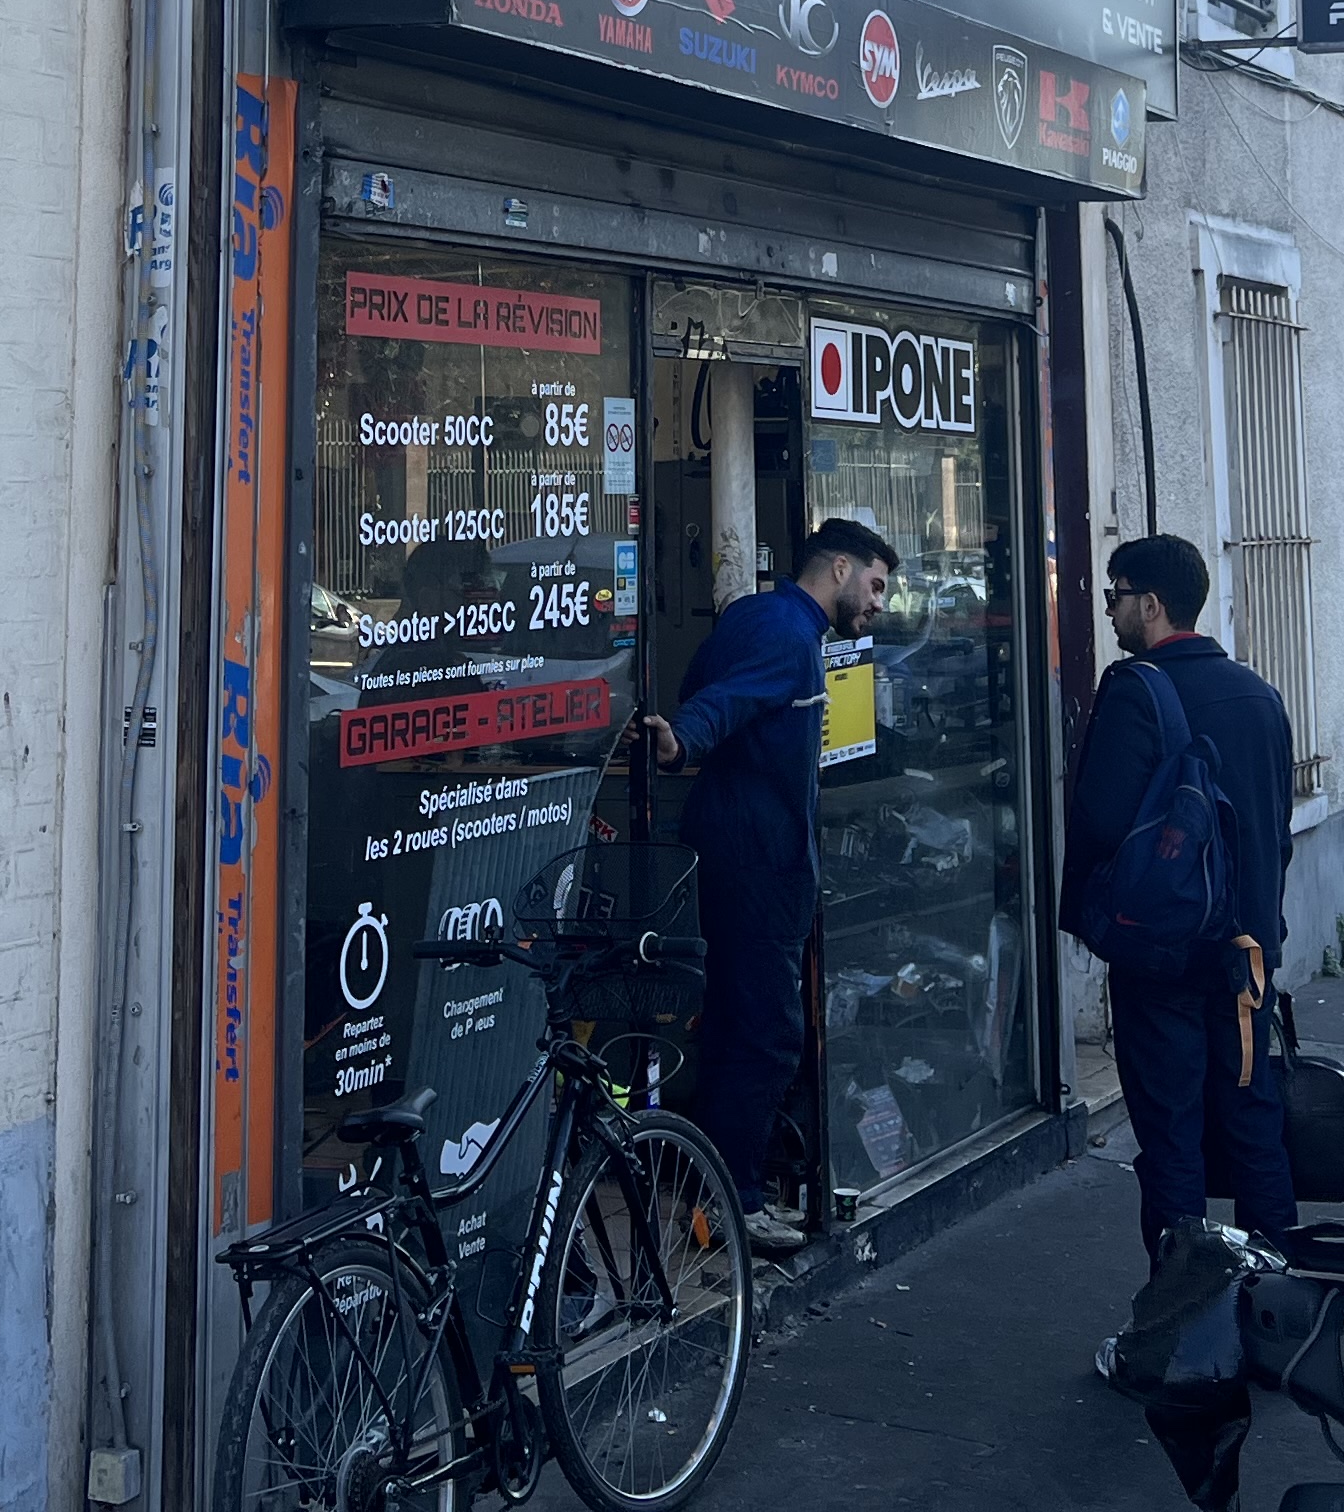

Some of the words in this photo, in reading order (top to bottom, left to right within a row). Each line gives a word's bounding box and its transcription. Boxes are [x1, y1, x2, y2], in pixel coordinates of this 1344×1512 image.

[598, 13, 653, 54] YAMAHA
[679, 27, 757, 75] SUZUKI
[1102, 7, 1114, 36] &
[1116, 12, 1163, 55] VENTE
[859, 38, 900, 82] SYM
[916, 40, 982, 101] Vespa
[775, 63, 840, 101] KYMCO
[1038, 119, 1090, 158] Kawasaki
[1102, 146, 1138, 175] PIAGGIO
[350, 286, 409, 323] PRIX
[417, 293, 450, 327] DE
[458, 297, 488, 330] LA
[496, 294, 597, 340] RÉVISION
[236, 307, 258, 486] Transfert
[531, 380, 537, 395] à
[539, 381, 563, 398] partir
[564, 381, 576, 397] de
[851, 329, 975, 427] IPONE
[359, 412, 439, 446] Scooter
[444, 414, 493, 447] 50CC
[544, 402, 590, 447] 85€
[538, 473, 563, 489] partir
[564, 472, 576, 486] de
[359, 512, 439, 546] Scooter
[444, 508, 504, 541] 125CC
[531, 492, 590, 538] 185€
[530, 561, 537, 578] à
[539, 560, 562, 580] partir
[564, 560, 576, 576] de
[358, 610, 440, 649] Scooter
[529, 580, 591, 630] 245€
[361, 671, 394, 691] Toutes
[396, 667, 411, 685] les
[412, 665, 444, 687] pièces
[445, 663, 466, 679] sont
[468, 659, 504, 677] fournies
[506, 657, 520, 673] sur
[521, 653, 545, 673] place
[346, 703, 470, 757] GARAGE
[497, 687, 601, 734] ATELIER
[419, 779, 493, 819] Spécialisé
[495, 776, 529, 801] dans
[365, 835, 389, 861] les
[392, 830, 403, 856] 2
[405, 825, 449, 853] roues
[451, 810, 518, 849] (scooters
[527, 797, 573, 827] motos)
[224, 892, 245, 1085] Transfert
[443, 987, 504, 1019] Changement
[335, 1048, 348, 1062] en
[348, 1037, 378, 1058] moins
[379, 1032, 392, 1048] de
[343, 1015, 384, 1039] Repartez
[450, 1022, 464, 1040] de
[457, 1211, 487, 1237] Achat
[458, 1237, 486, 1260] Vente
